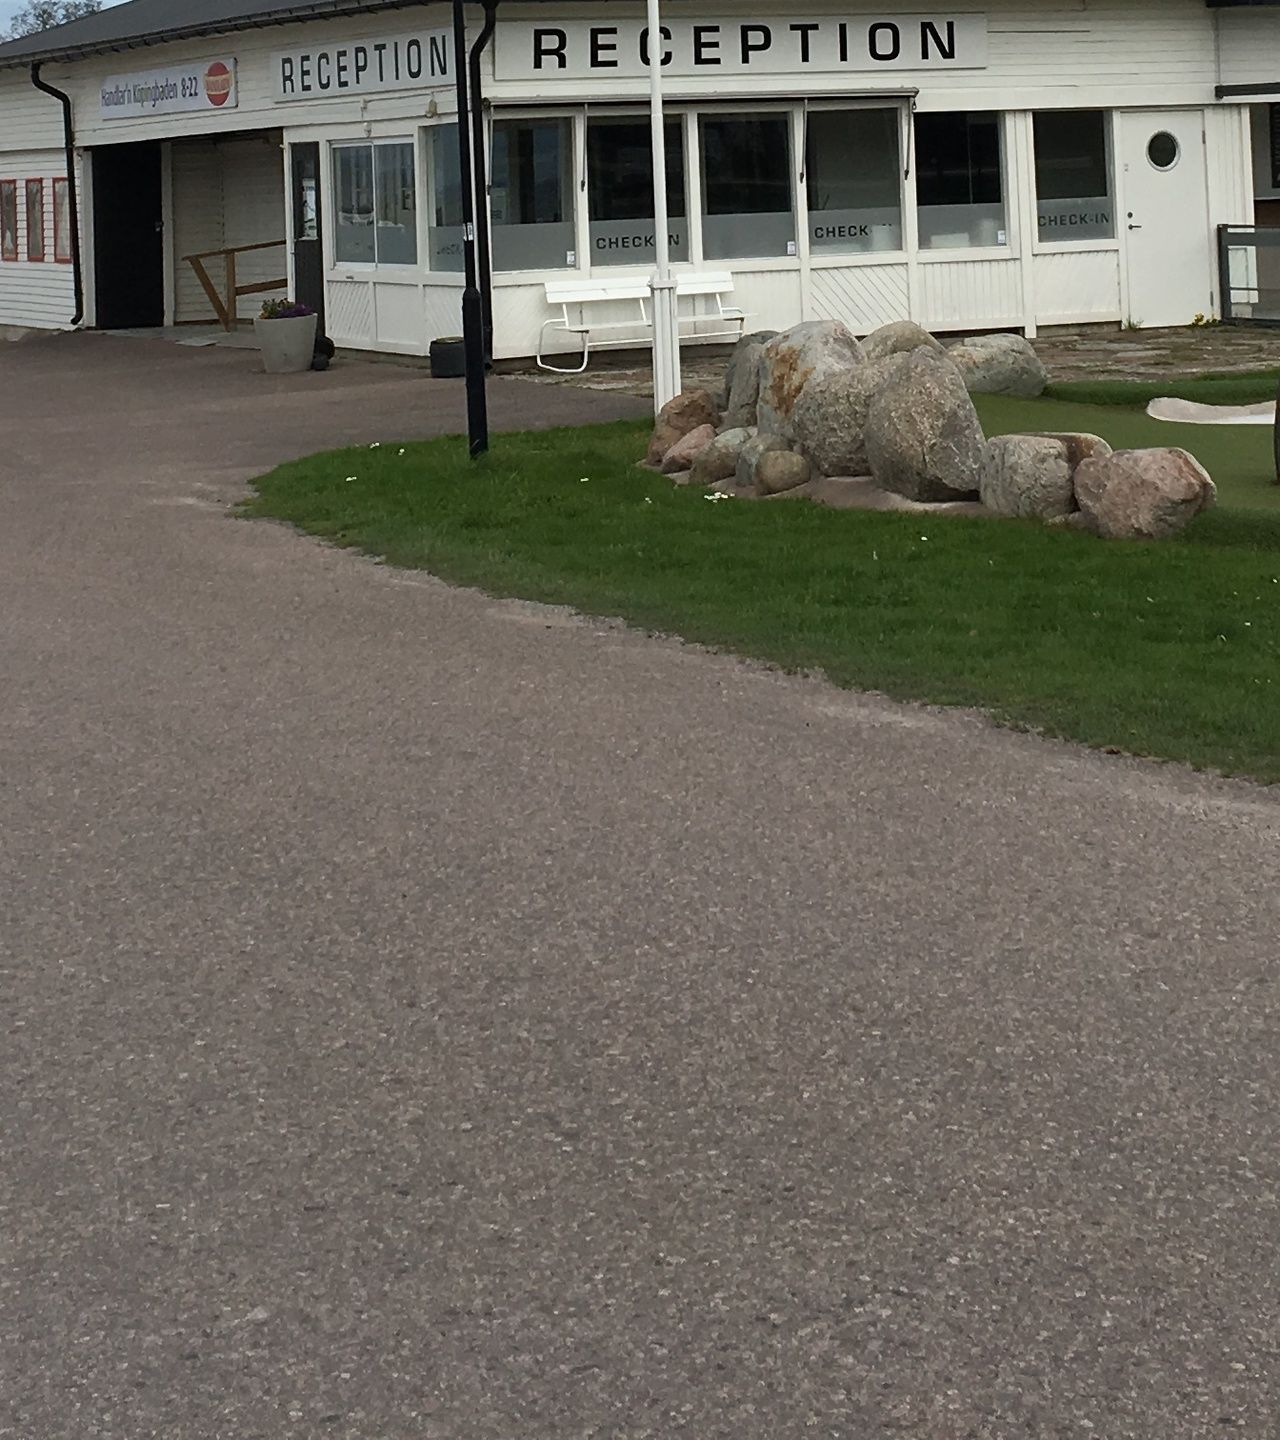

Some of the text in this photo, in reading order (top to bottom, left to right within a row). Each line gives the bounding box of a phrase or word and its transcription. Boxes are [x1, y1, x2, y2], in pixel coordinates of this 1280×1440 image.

[281, 34, 448, 94] RECEPTION
[532, 20, 956, 70] RECEPTION
[1037, 212, 1110, 227] CHECK-IN
